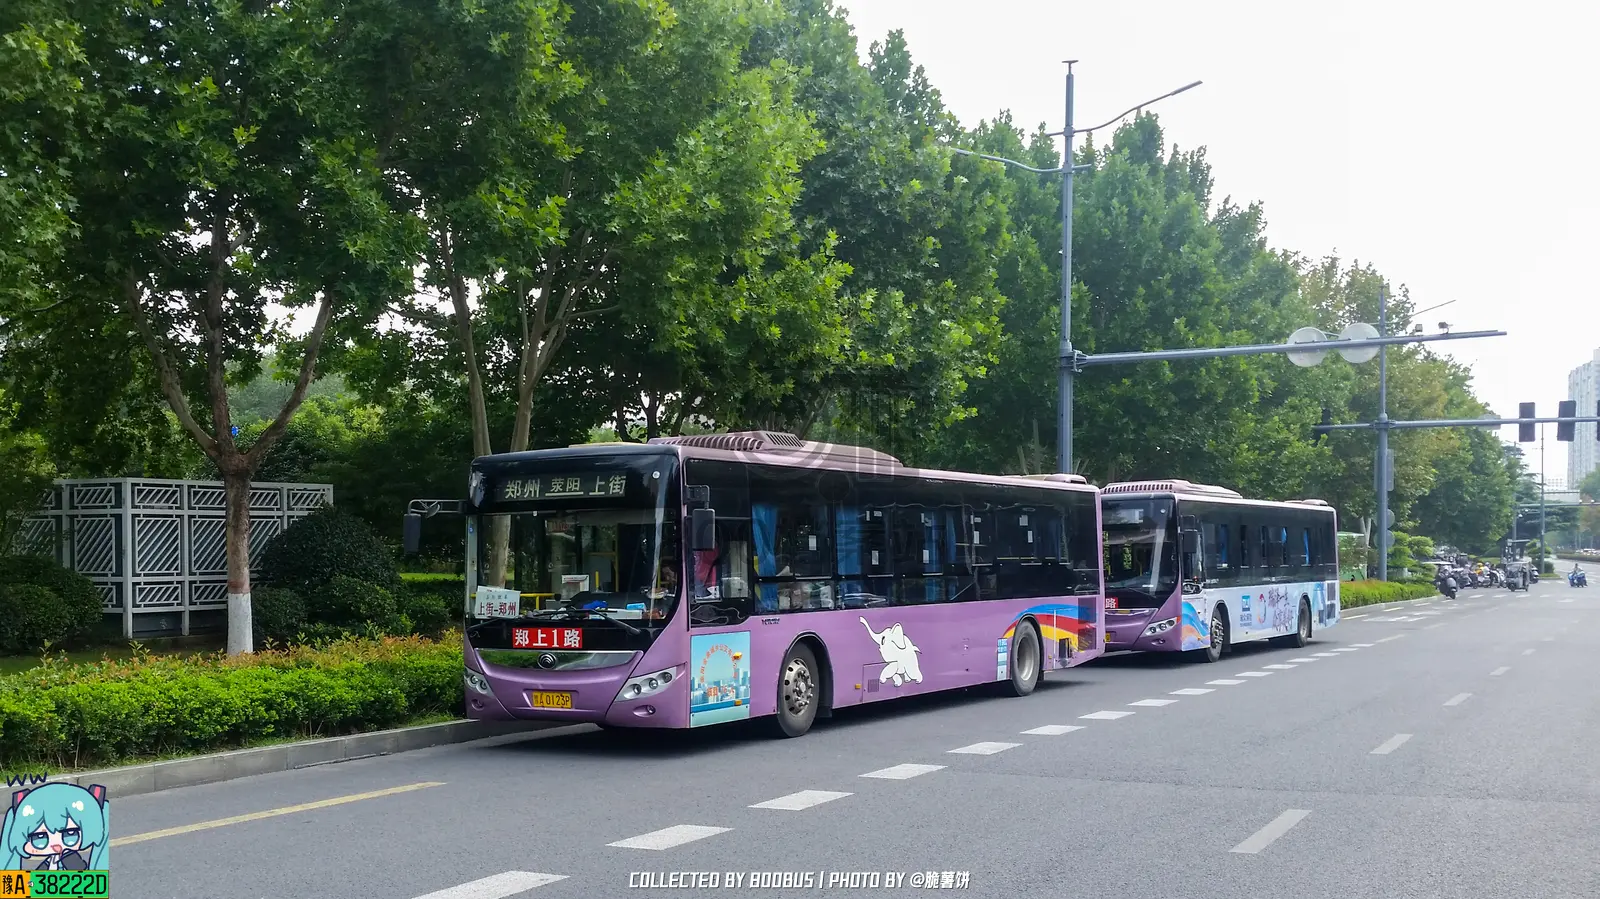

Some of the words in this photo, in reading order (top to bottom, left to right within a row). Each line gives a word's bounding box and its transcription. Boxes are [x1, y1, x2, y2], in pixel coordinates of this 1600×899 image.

[504, 479, 541, 499] 郑州
[549, 477, 581, 493] 荥阳
[588, 475, 627, 496] 上街
[515, 629, 581, 648] 郑上1路
